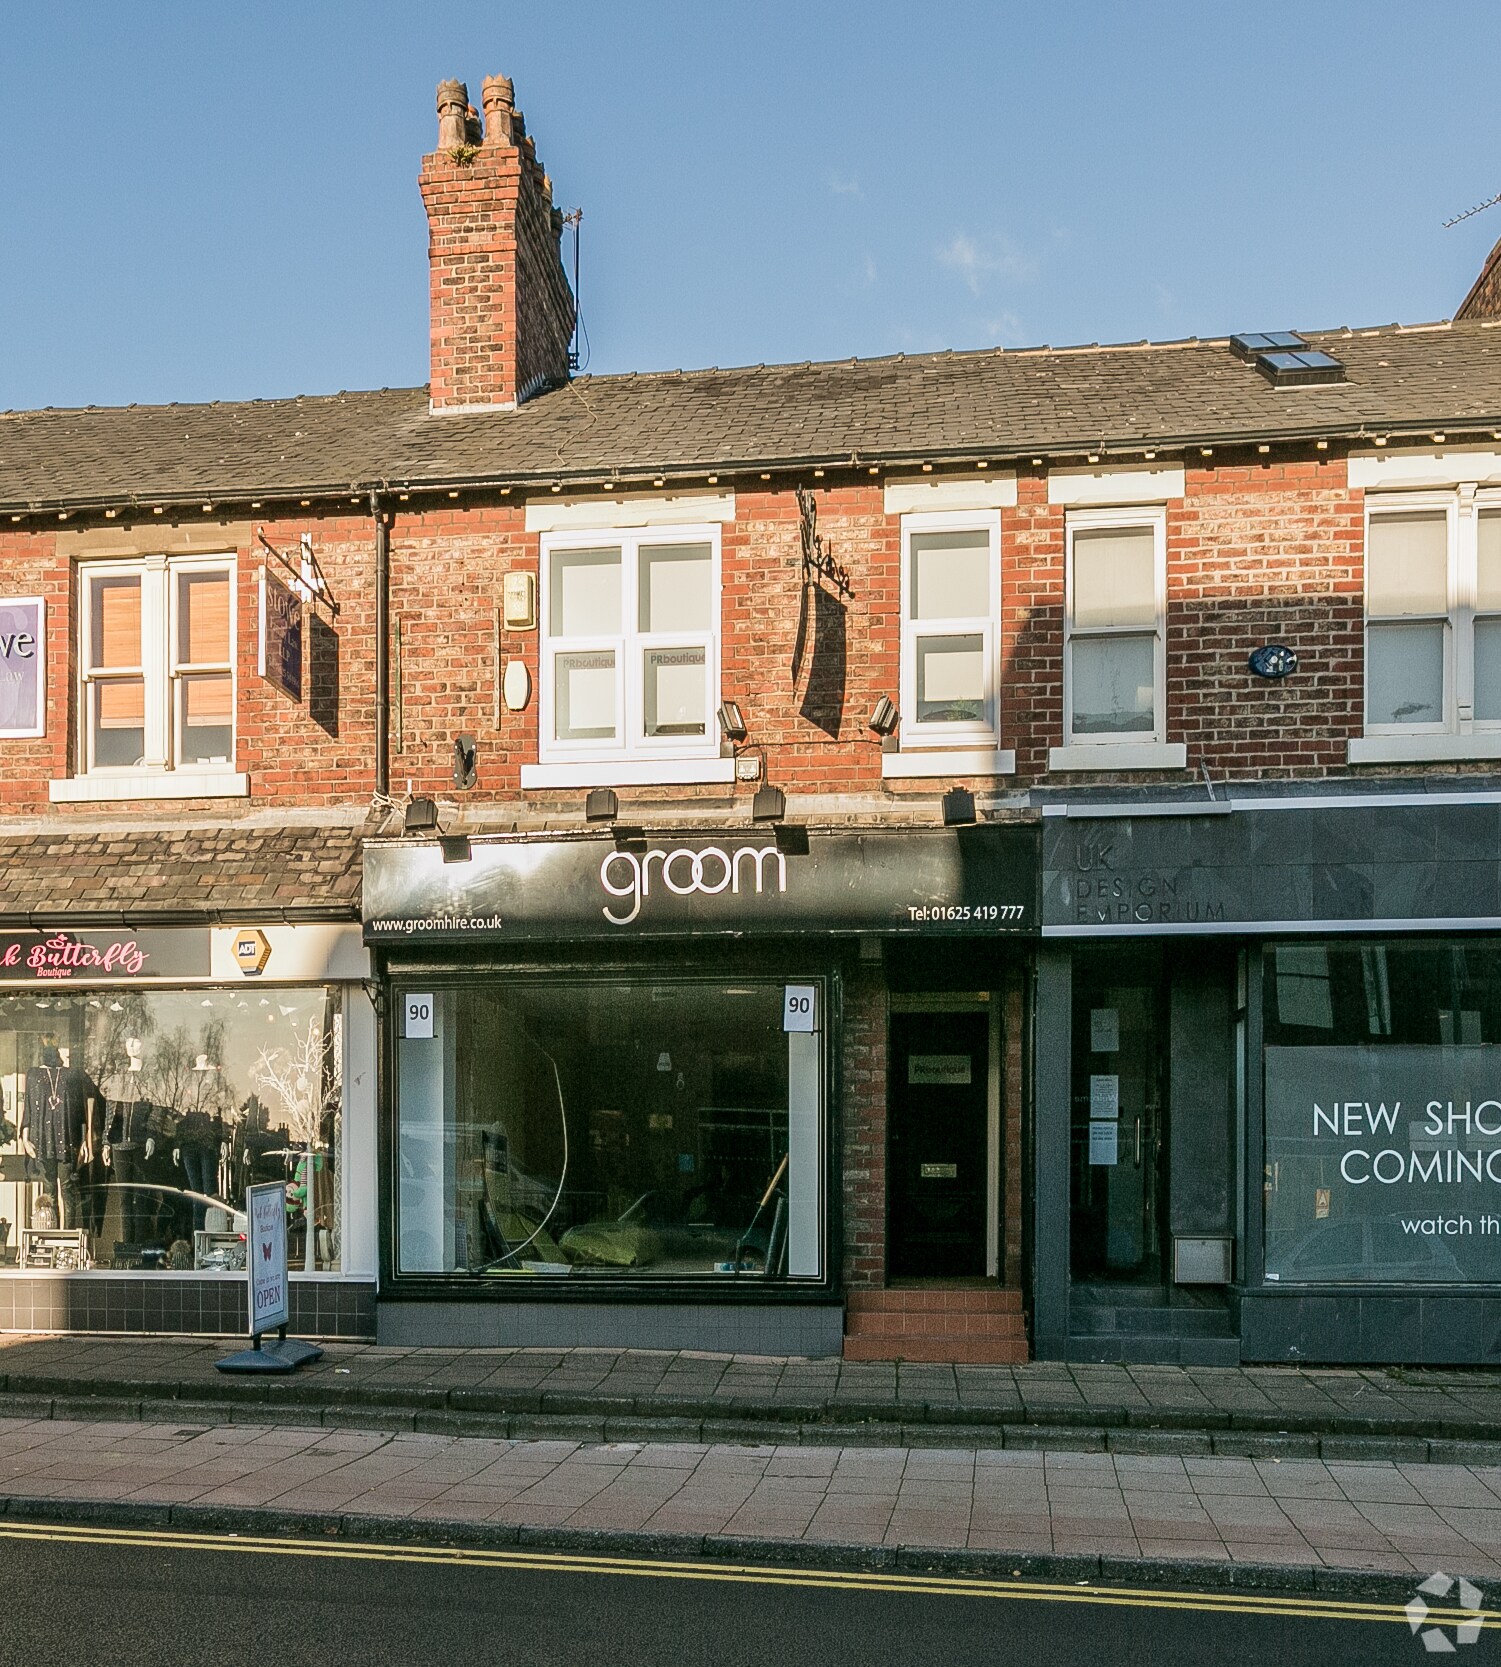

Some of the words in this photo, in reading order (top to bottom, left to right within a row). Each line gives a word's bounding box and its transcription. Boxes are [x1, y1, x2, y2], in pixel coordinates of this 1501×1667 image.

[563, 656, 616, 668] PRboutiqu
[1076, 843, 1113, 872] UK
[600, 846, 787, 925] groom
[1076, 877, 1178, 899] DESIGN
[973, 905, 998, 920] 419
[1000, 905, 1025, 920] 777
[1076, 902, 1225, 923] EMPORIUM
[372, 914, 502, 934] www.groomhire.co.uk
[27, 940, 150, 973] Butterfly
[239, 943, 256, 955] ADT
[37, 966, 72, 978] Boutique
[409, 1004, 429, 1020] 90
[789, 996, 810, 1013] 90
[1313, 1101, 1401, 1136] NEW
[1424, 1100, 1501, 1136] SHO
[1401, 1215, 1473, 1235] watch
[1479, 1215, 1500, 1235] th
[257, 1285, 281, 1309] OPEN
